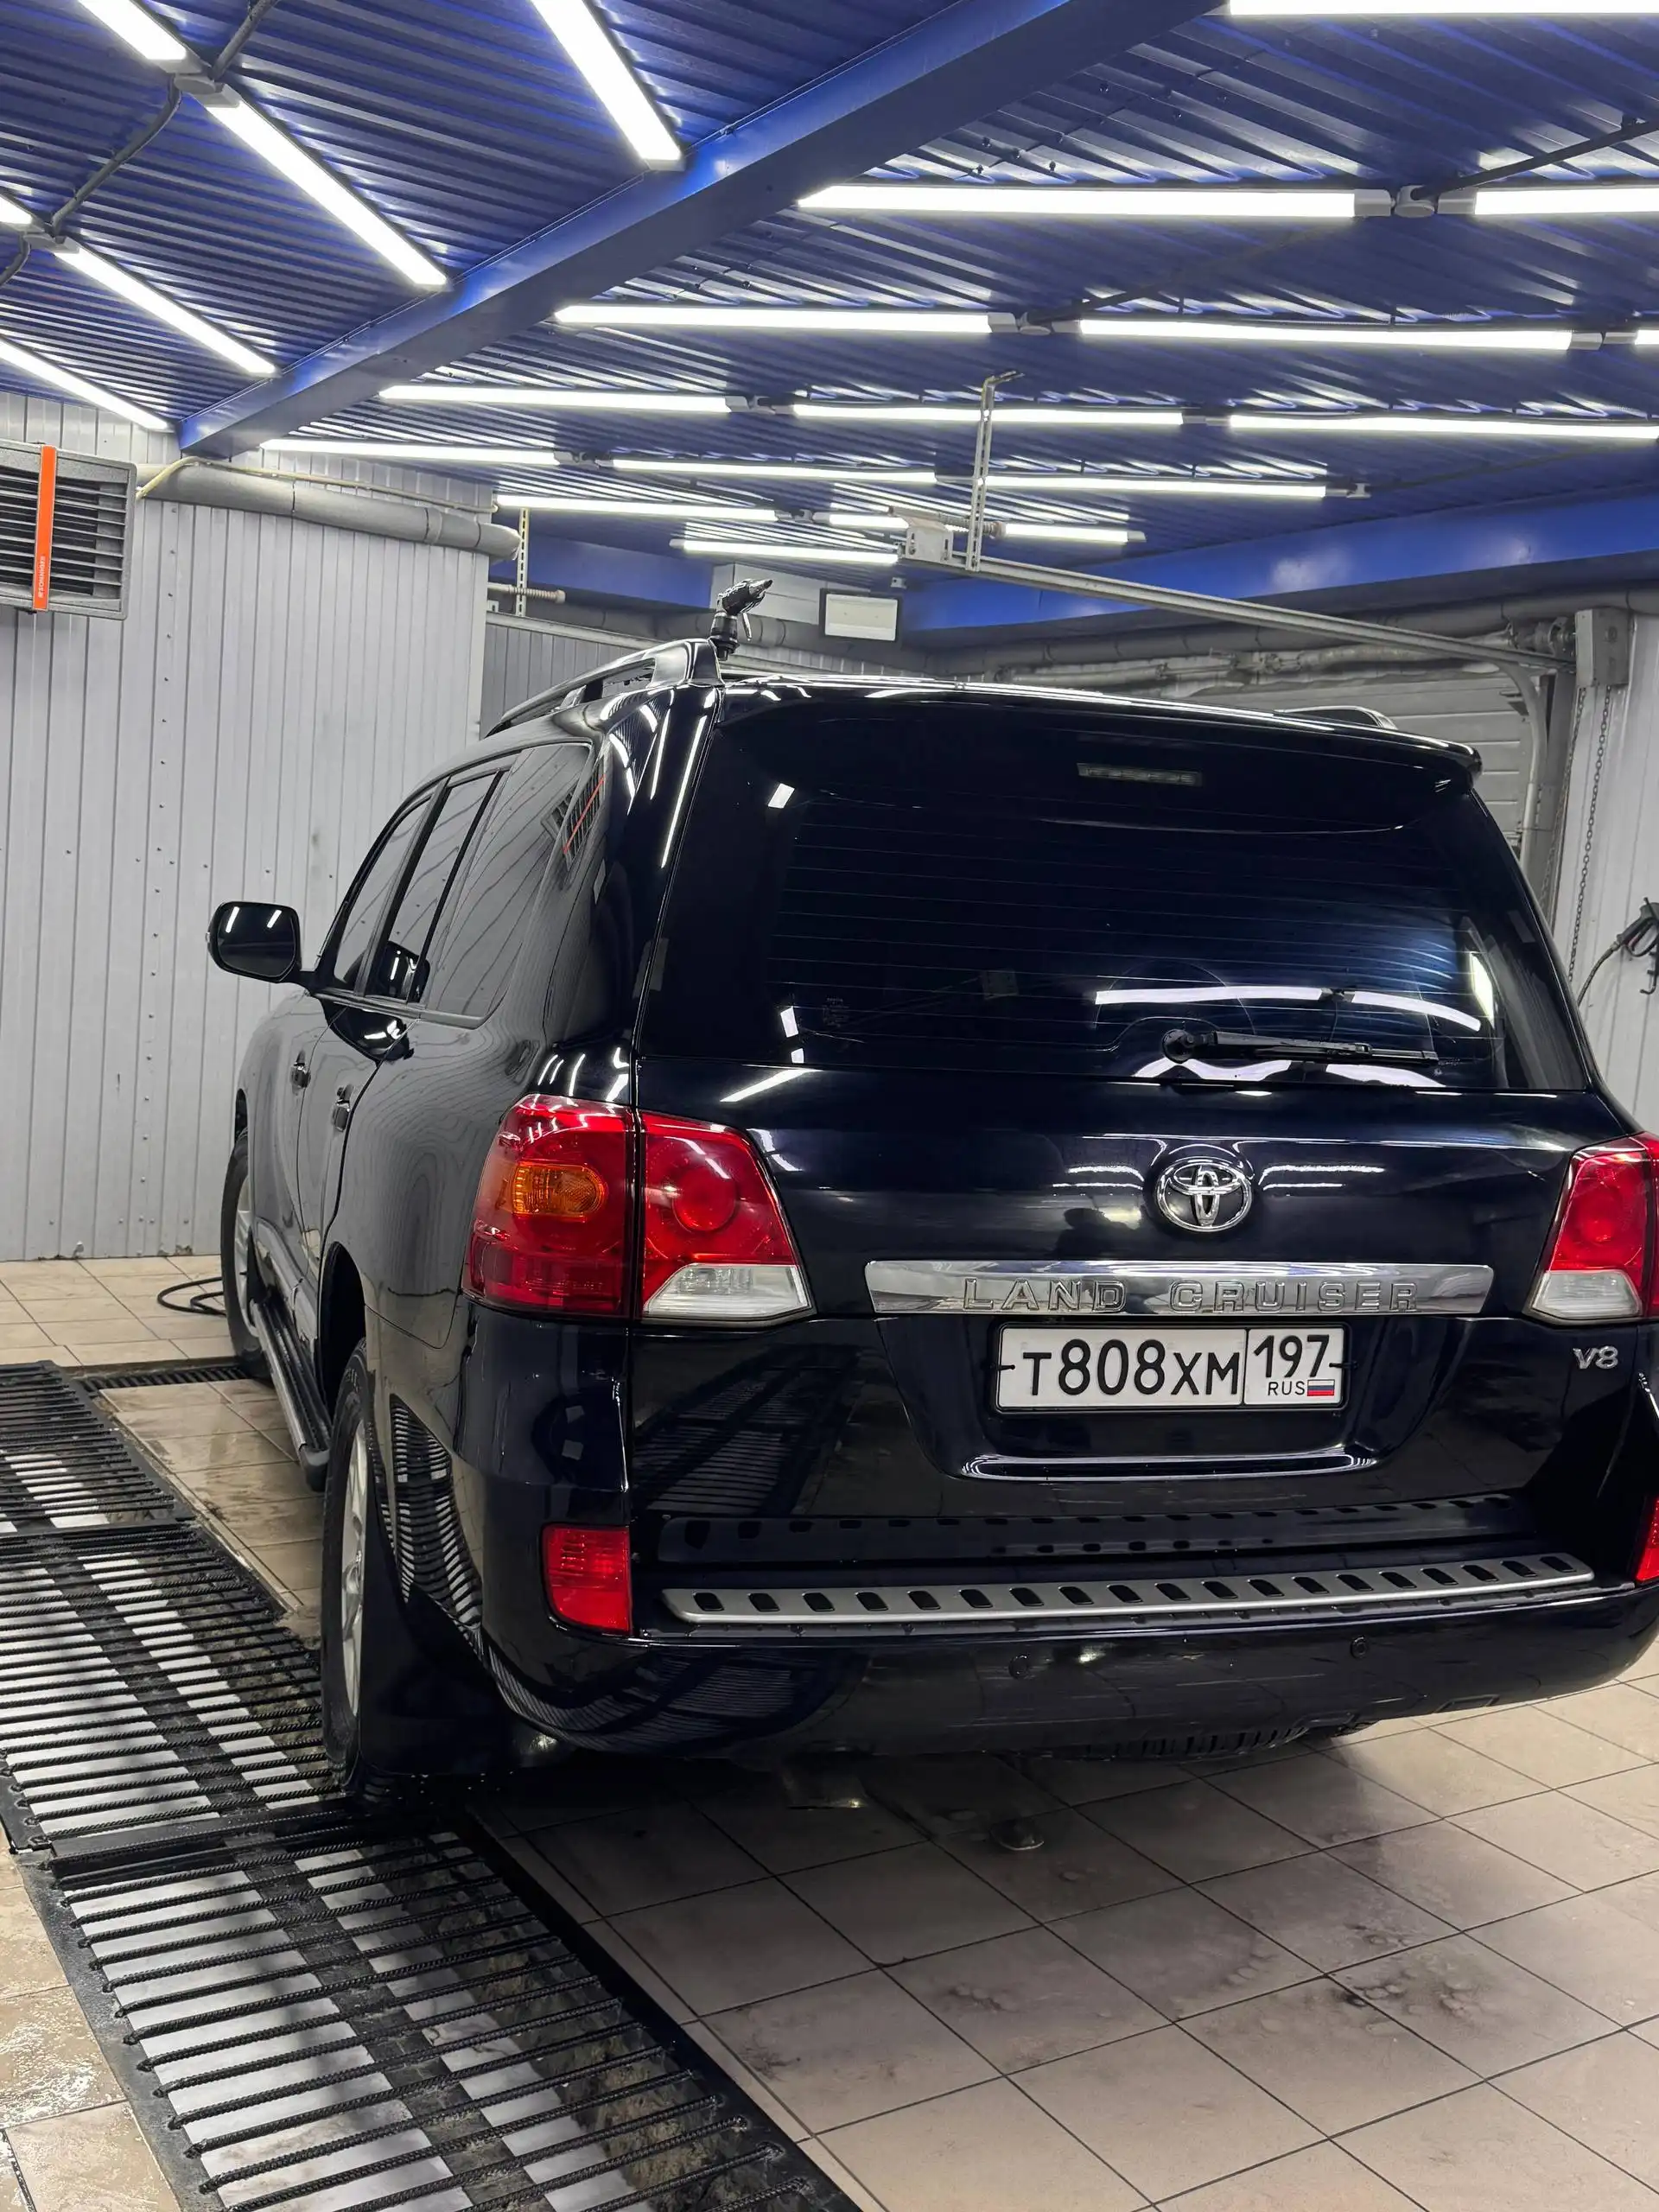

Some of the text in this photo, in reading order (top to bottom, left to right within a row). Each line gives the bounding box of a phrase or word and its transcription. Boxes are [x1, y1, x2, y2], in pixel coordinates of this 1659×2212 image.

[963, 1278, 1418, 1313] LAND CRUISER
[1022, 1334, 1331, 1396] Т808ХМ 197
[1573, 1345, 1618, 1370] V8
[1267, 1381, 1306, 1396] RUS
